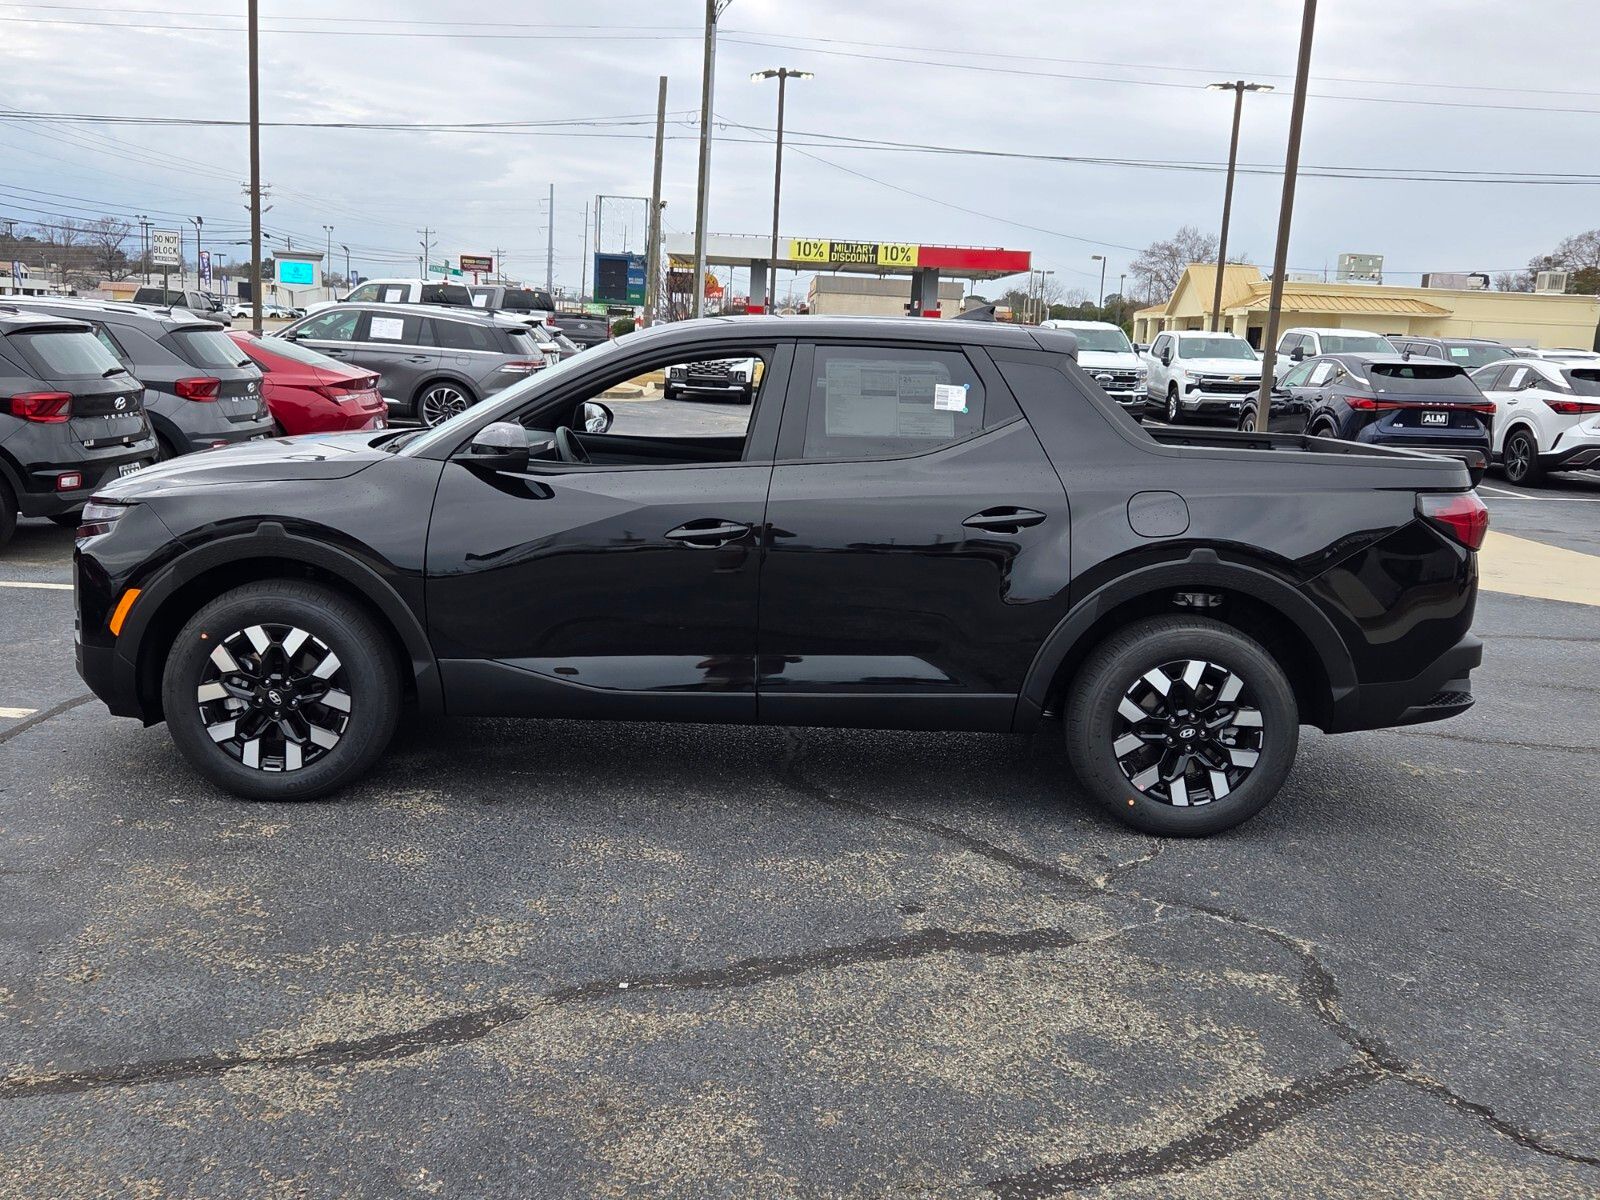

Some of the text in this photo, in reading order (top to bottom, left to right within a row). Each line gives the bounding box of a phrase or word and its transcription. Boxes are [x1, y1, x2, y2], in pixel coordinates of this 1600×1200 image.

[153, 235, 178, 244] DO NOT
[153, 246, 178, 255] BLOCK
[796, 242, 824, 258] 10%
[834, 244, 873, 254] MILITARY
[884, 246, 911, 262] 10%
[1424, 414, 1446, 423] ALM
